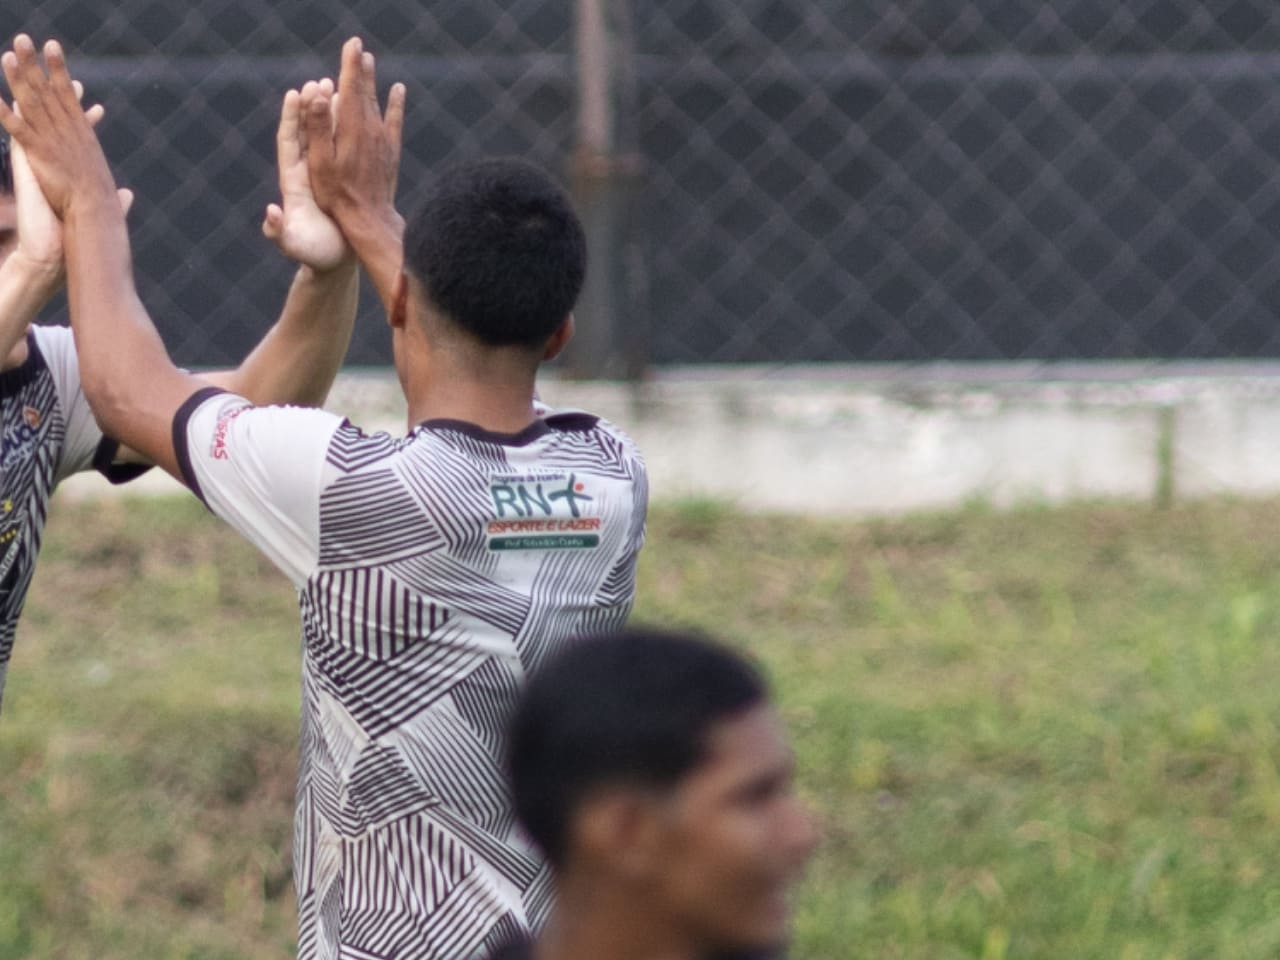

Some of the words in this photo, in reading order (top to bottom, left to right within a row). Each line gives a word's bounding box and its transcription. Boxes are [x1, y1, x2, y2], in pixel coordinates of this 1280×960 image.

[487, 520, 545, 533] ESPORTE
[546, 519, 555, 531] E
[557, 517, 601, 530] LAZER
